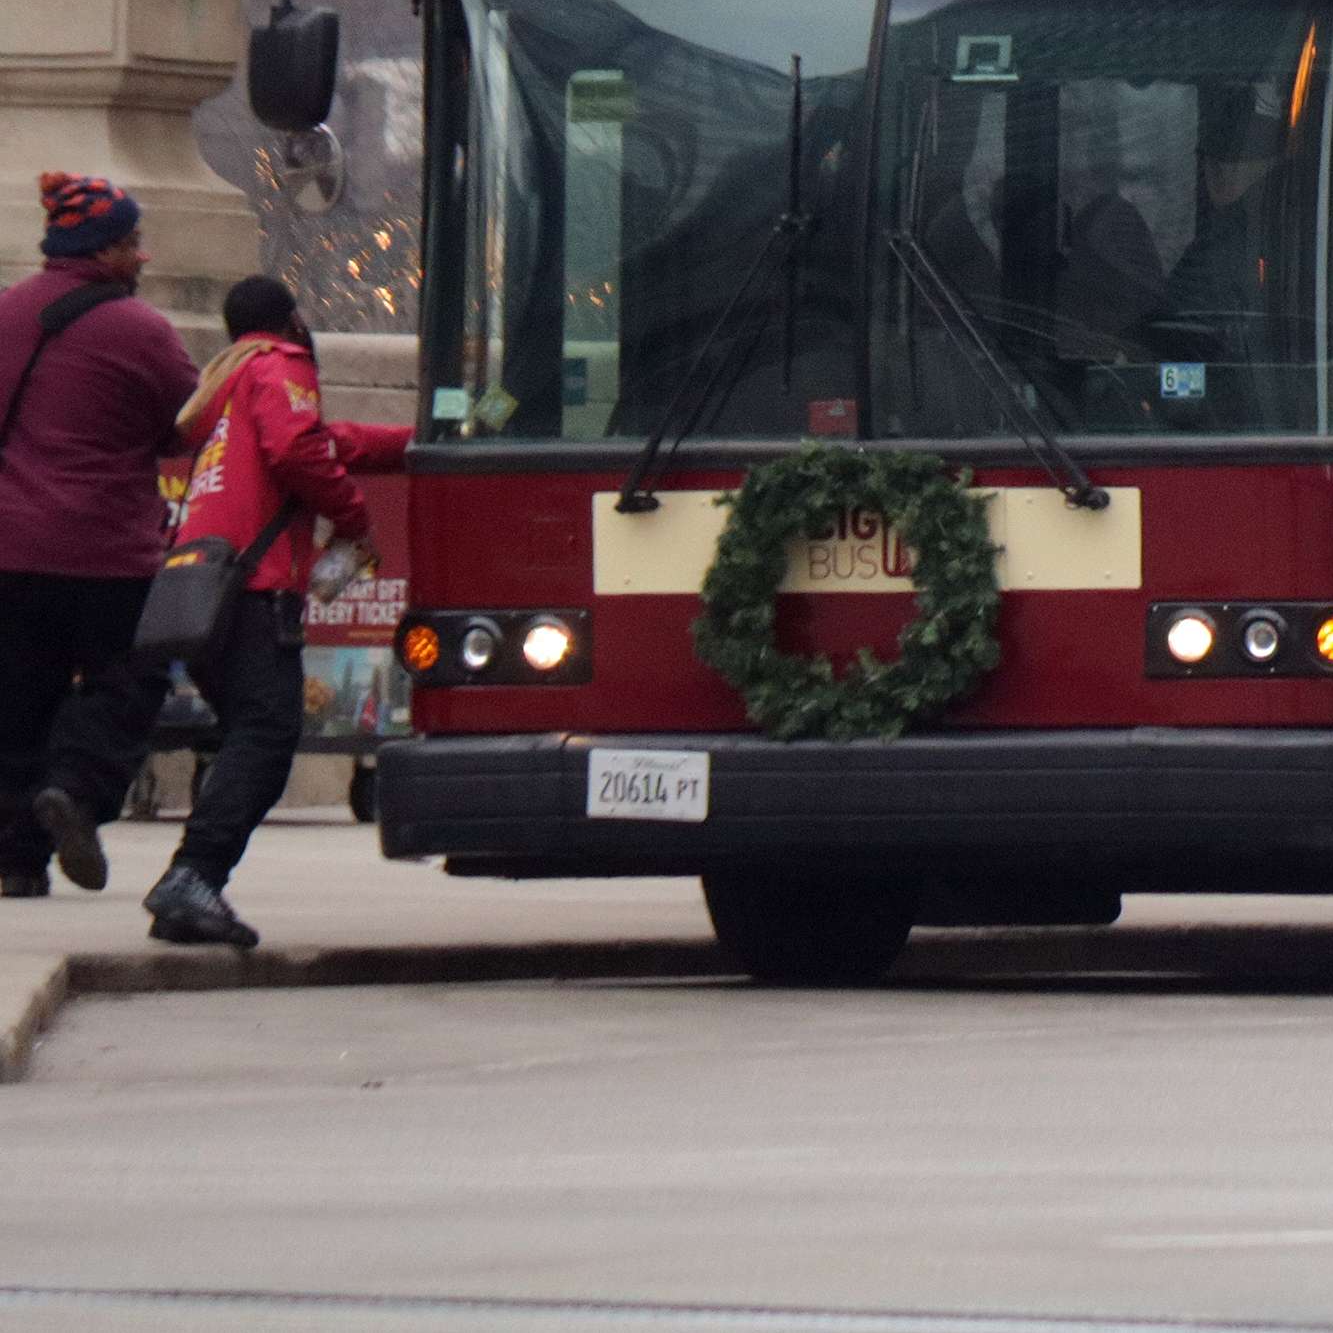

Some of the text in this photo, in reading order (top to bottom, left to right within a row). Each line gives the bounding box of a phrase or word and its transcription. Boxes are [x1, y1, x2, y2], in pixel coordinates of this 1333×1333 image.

[808, 544, 878, 581] BUS
[600, 770, 699, 803] 20614 PT
